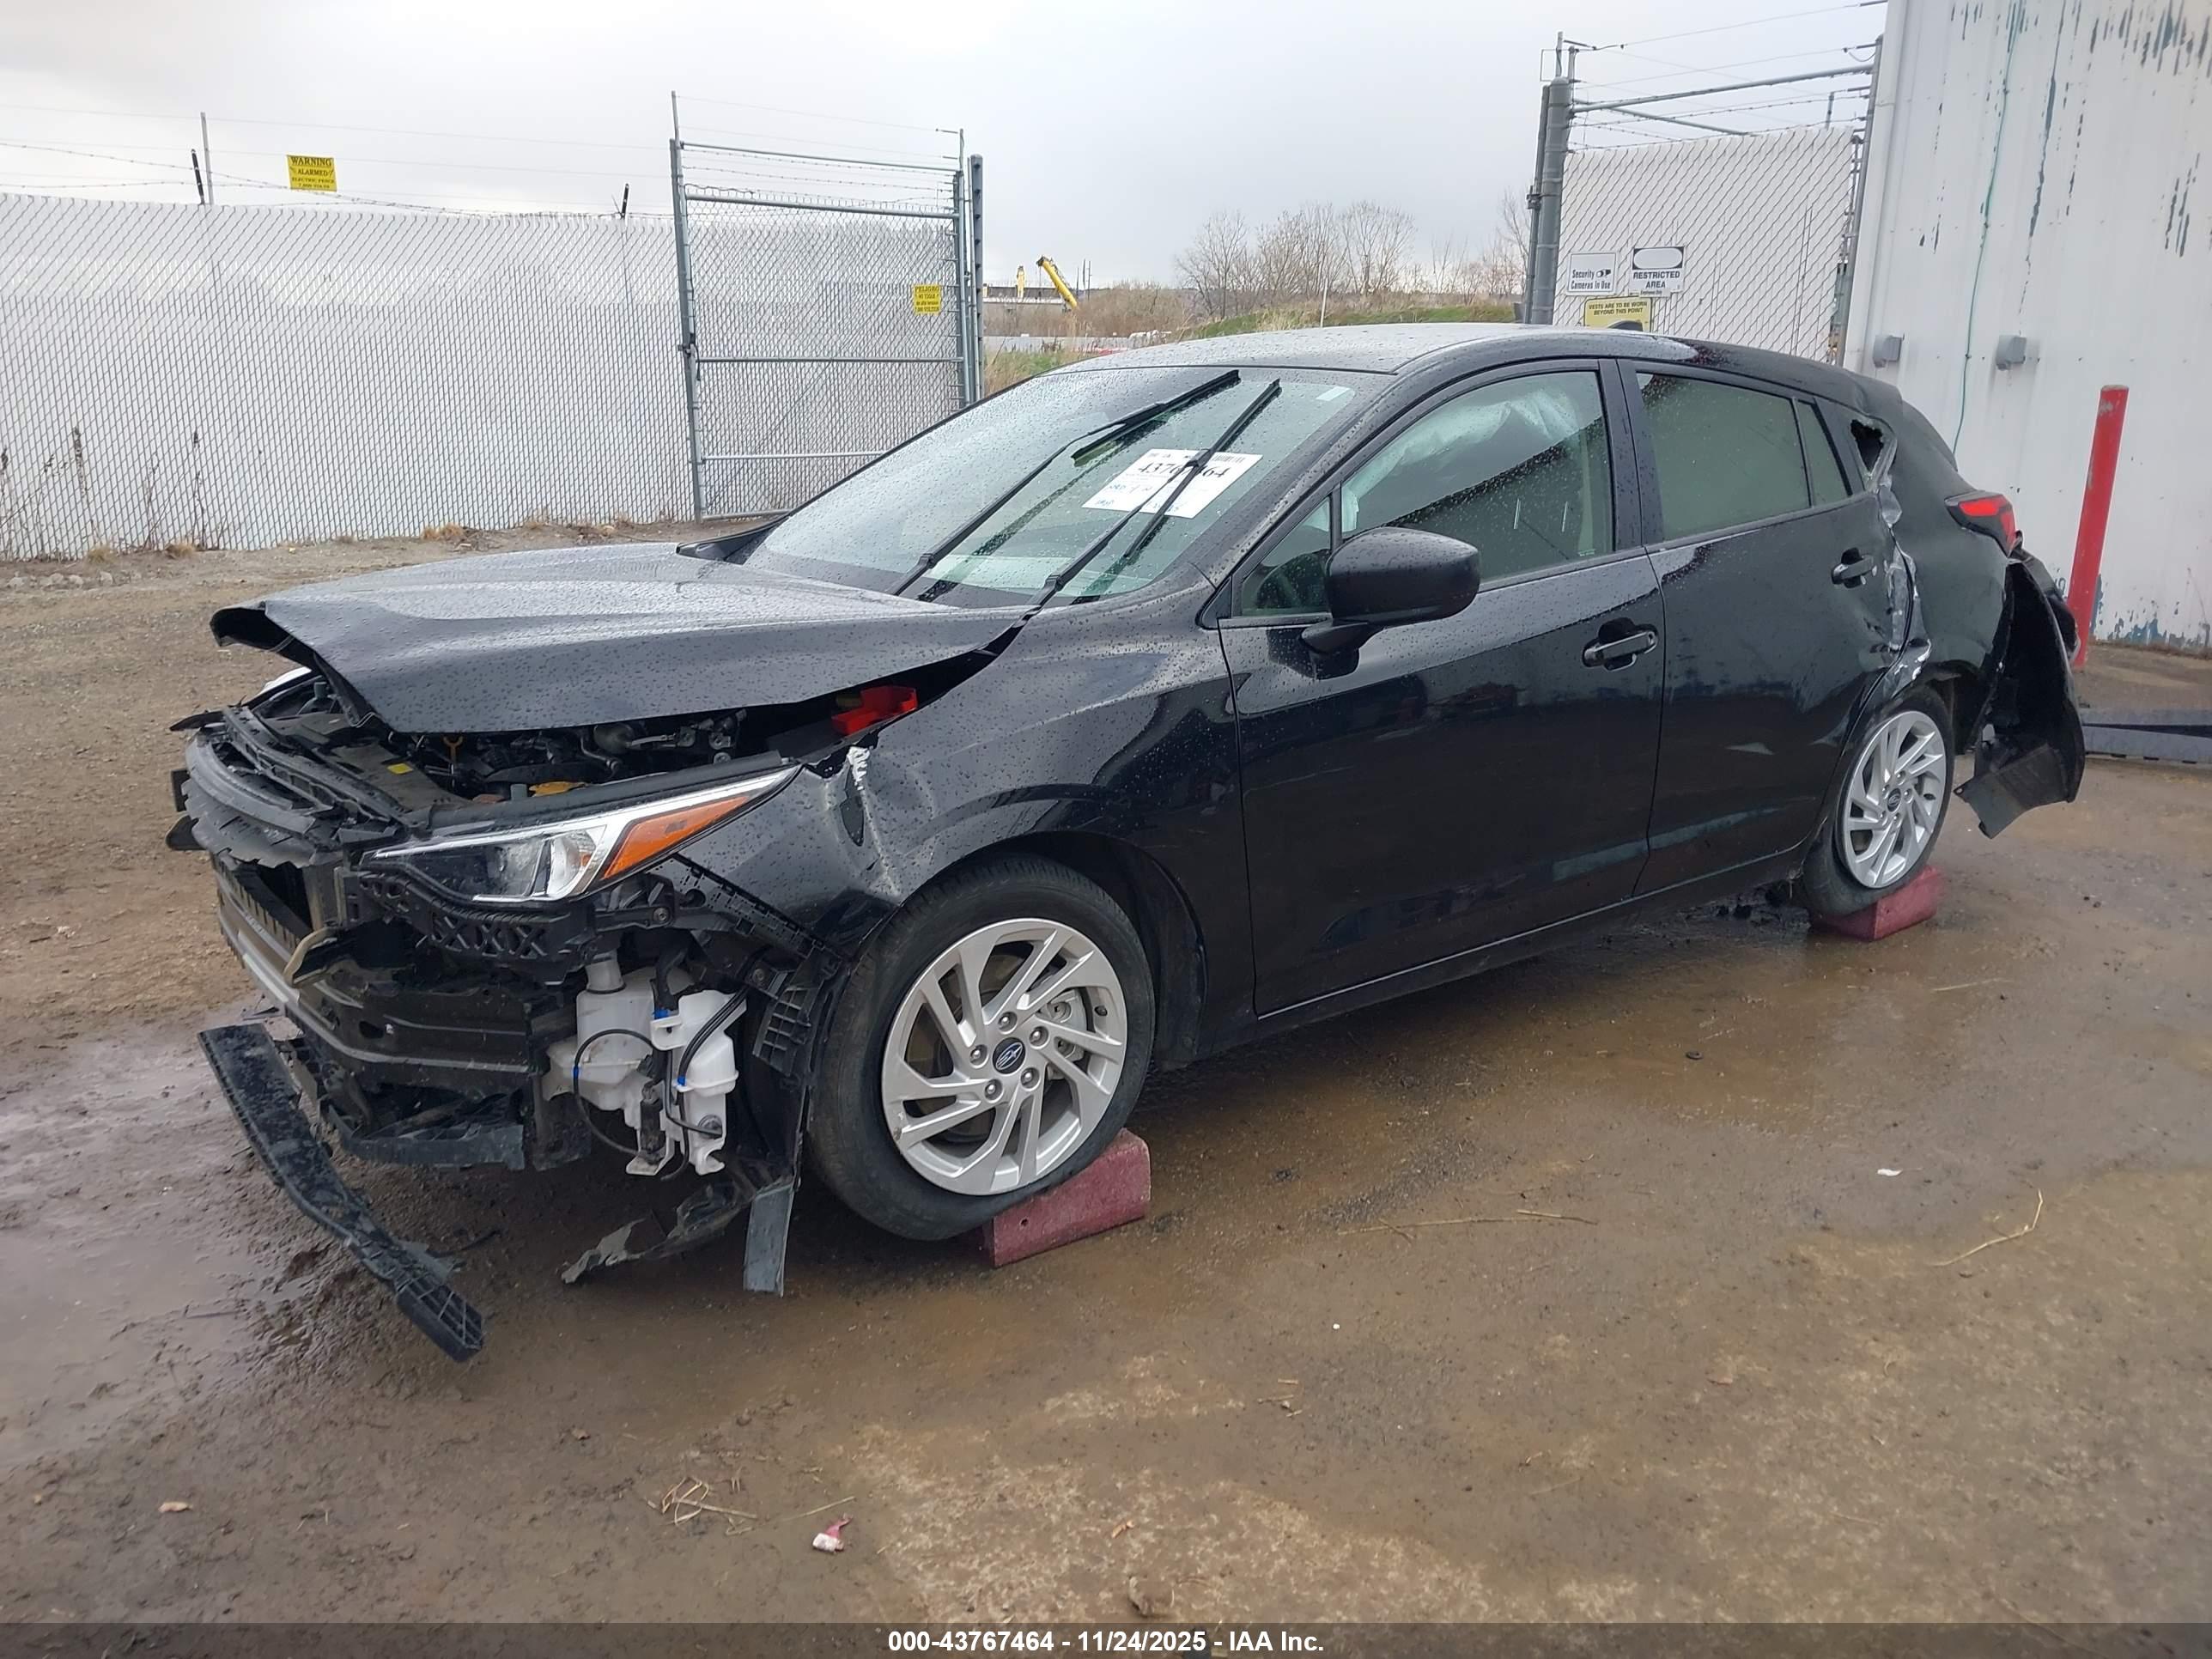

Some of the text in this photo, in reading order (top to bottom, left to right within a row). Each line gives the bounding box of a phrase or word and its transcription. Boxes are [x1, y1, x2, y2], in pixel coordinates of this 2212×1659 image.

[292, 155, 332, 167] WARNING
[1571, 269, 1595, 280] Security
[1632, 270, 1680, 280] RESTRICTED
[1571, 280, 1593, 289] Cameras
[1601, 280, 1611, 289] Use
[1645, 281, 1666, 289] AREA
